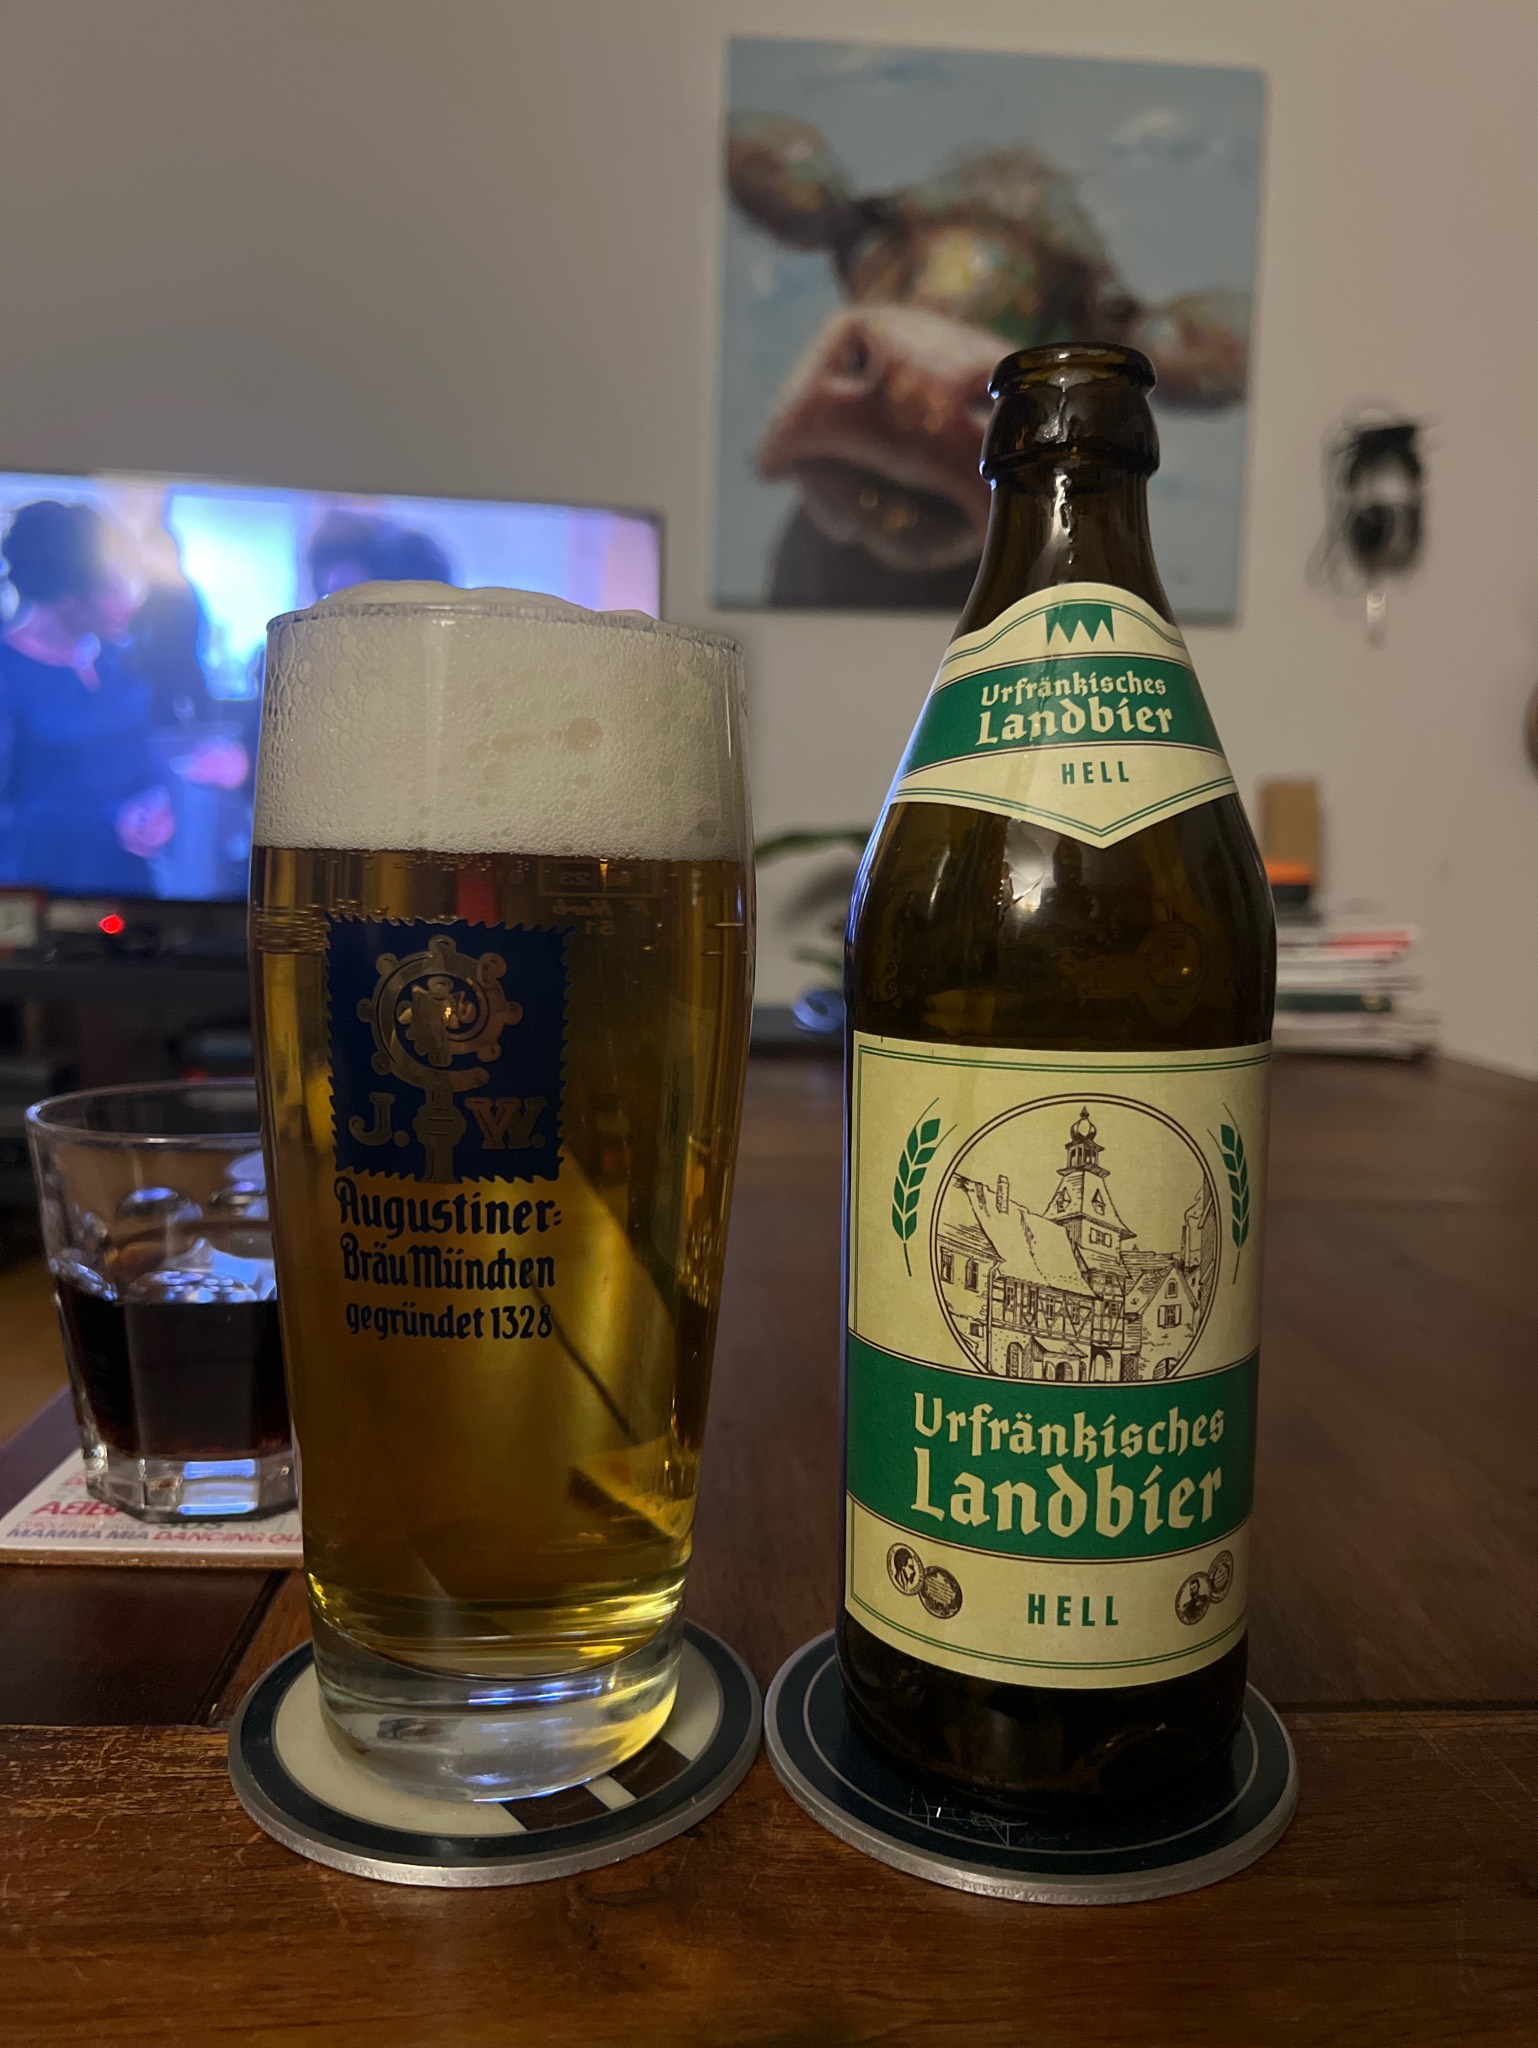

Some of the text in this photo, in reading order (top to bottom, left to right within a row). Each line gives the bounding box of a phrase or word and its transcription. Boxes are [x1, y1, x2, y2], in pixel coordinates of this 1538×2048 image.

[980, 670, 1166, 707] Urfränkisches
[975, 697, 1173, 746] Landbier
[1061, 761, 1129, 785] HELL
[340, 1232, 556, 1291] Bräu München
[346, 1302, 553, 1340] gegründet 1328
[913, 1392, 1225, 1463] Urfränkisches
[30, 1500, 118, 1516] ABB
[910, 1446, 1222, 1538] Landbier
[269, 1531, 303, 1544] QU
[1027, 1593, 1119, 1626] HELL
